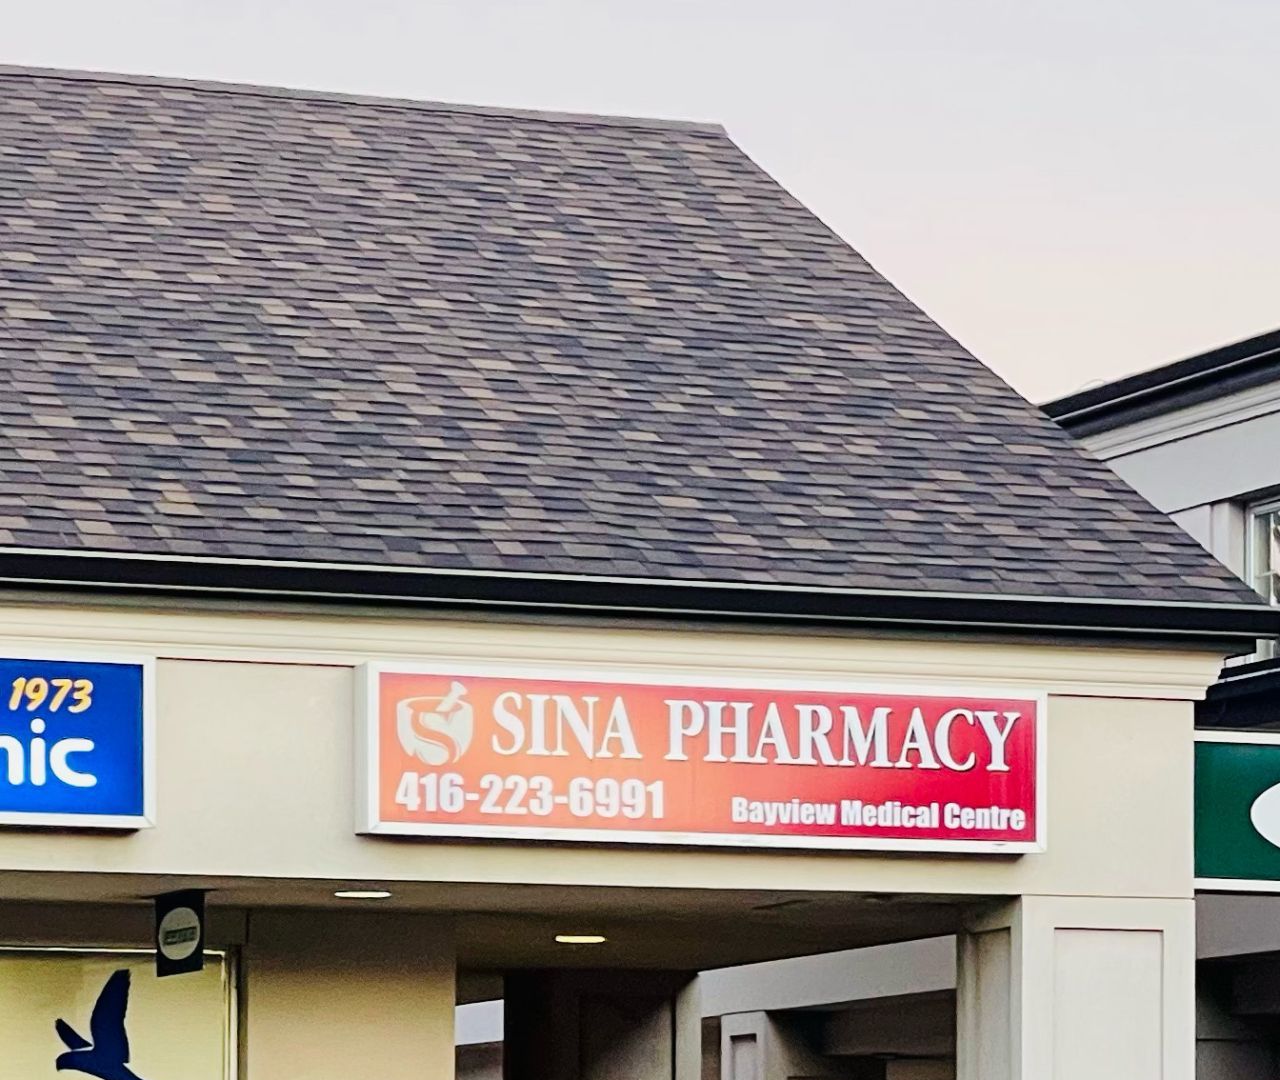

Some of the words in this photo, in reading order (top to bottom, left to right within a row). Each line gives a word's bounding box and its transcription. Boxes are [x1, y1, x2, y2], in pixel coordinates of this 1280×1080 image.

[9, 677, 94, 713] 1973
[491, 691, 644, 761] SINA
[664, 699, 1022, 773] PHARMACY
[394, 771, 665, 819] 416-223-6991
[732, 796, 836, 827] Bayview
[840, 799, 939, 829] Medical
[943, 802, 1026, 831] Centre
